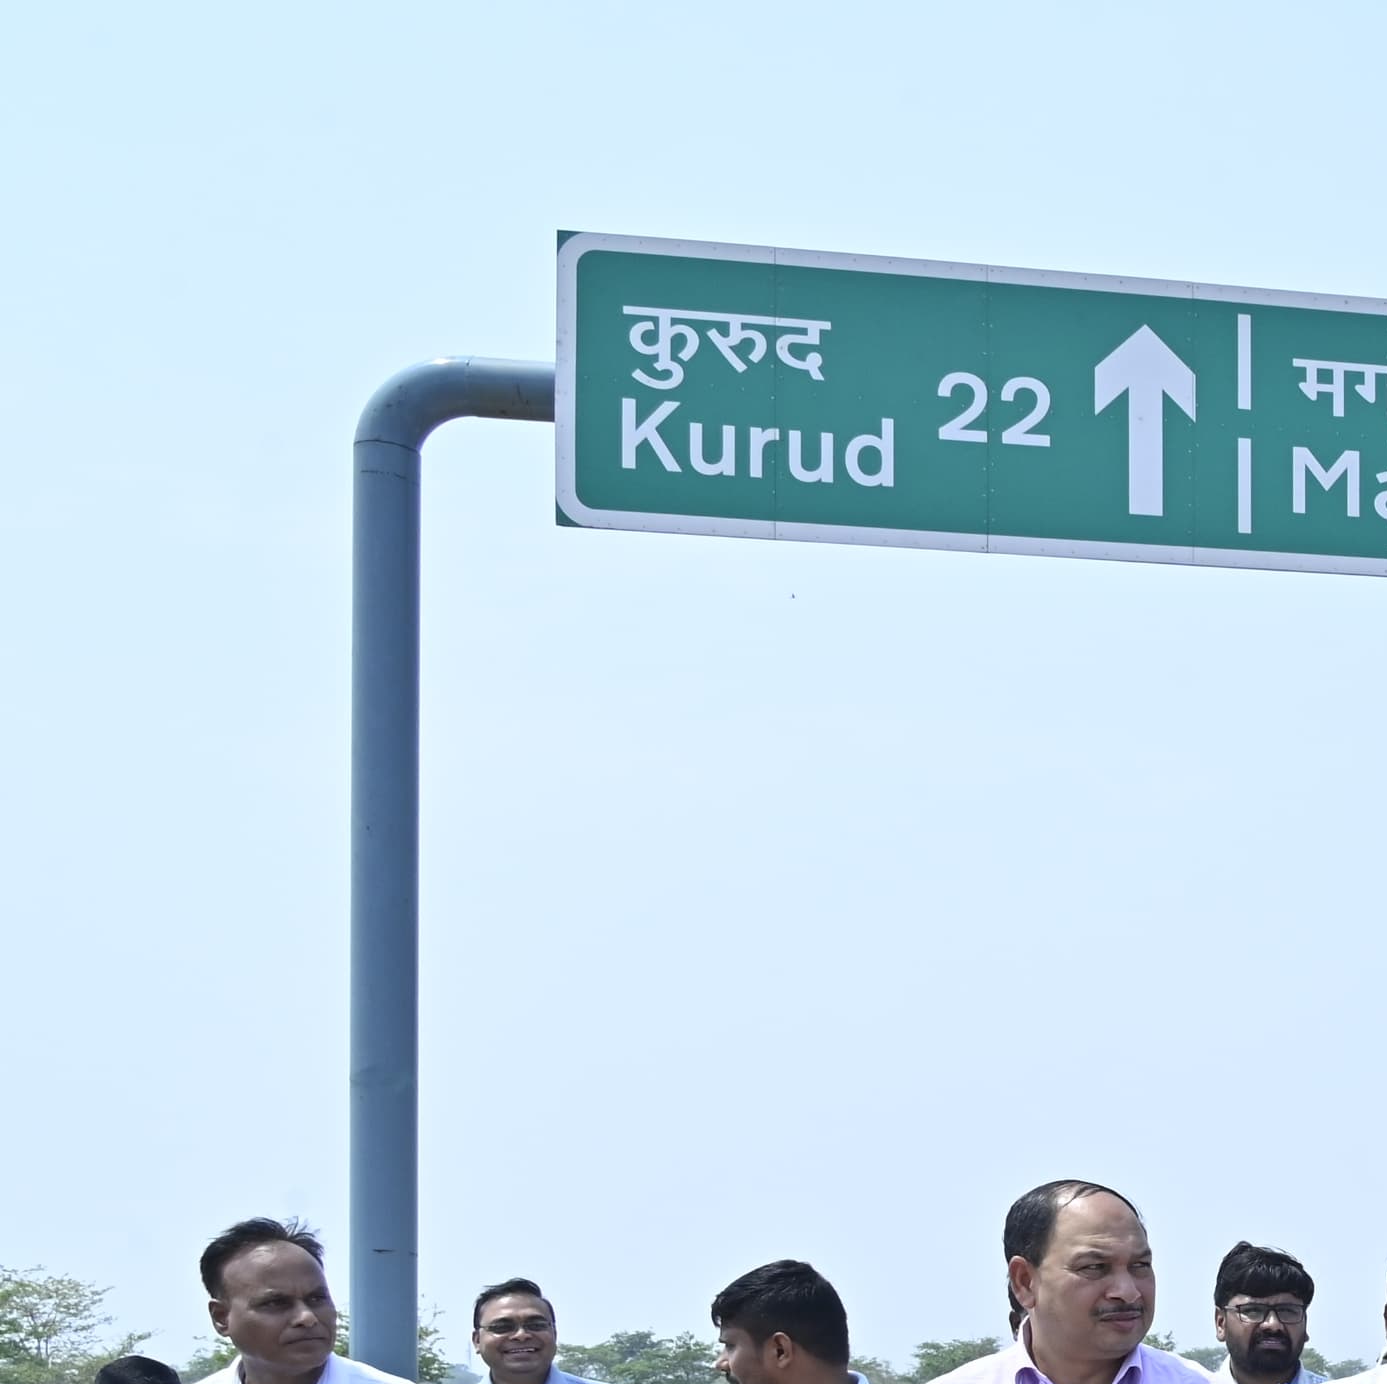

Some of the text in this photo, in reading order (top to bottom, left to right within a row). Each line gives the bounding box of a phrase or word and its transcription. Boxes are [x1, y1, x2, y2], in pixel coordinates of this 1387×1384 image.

[622, 305, 832, 390] कुरुद
[621, 397, 895, 488] Kurud
[937, 371, 1051, 448] 22
